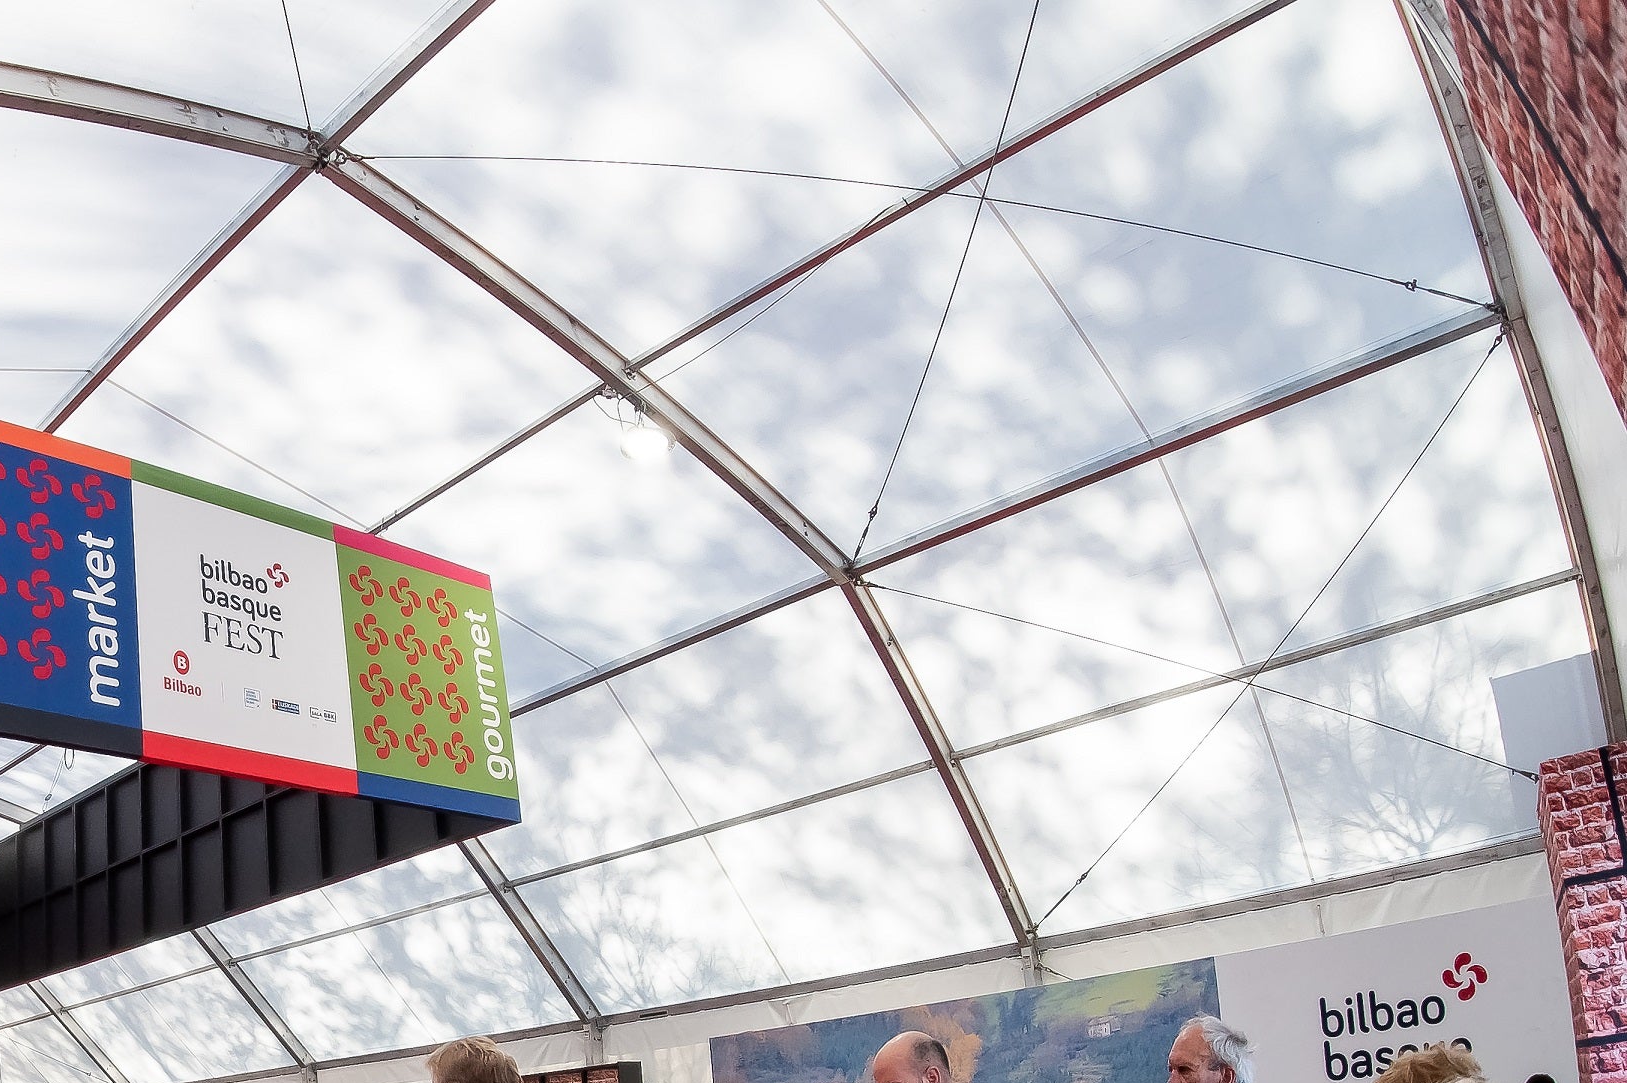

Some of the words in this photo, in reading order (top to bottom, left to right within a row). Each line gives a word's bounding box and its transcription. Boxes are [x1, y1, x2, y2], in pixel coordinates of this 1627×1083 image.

[200, 553, 268, 594] bilbao
[72, 530, 121, 707] market
[201, 578, 282, 621] basque
[201, 611, 284, 660] FEST
[163, 676, 203, 697] Bilbao
[464, 608, 514, 781] gourmet
[1319, 989, 1446, 1038] bilbao
